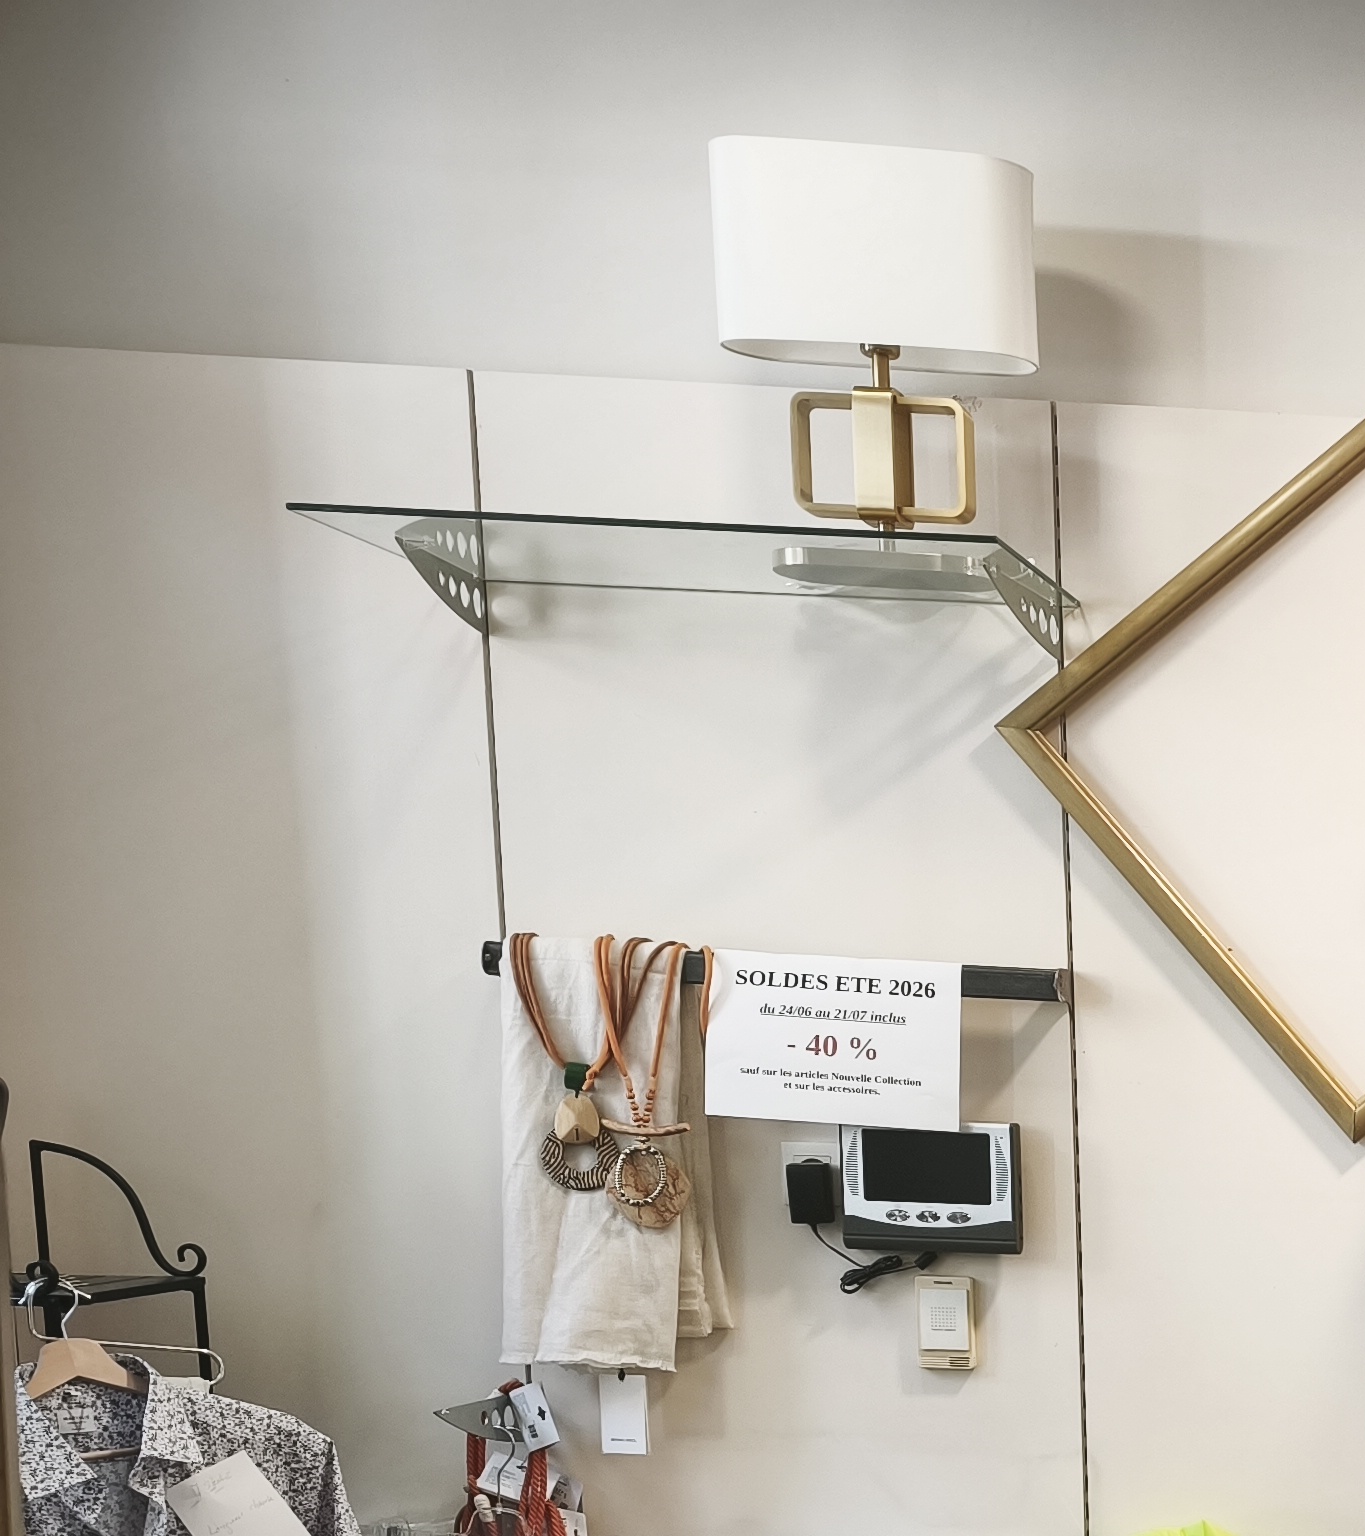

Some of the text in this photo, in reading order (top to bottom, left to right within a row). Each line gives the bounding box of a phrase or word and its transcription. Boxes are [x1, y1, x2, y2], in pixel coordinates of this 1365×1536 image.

[735, 969, 936, 999] SOLDES ETE 2026
[759, 1002, 906, 1024] du 24/06 au 21/07 inclus
[805, 1034, 838, 1057] 40
[849, 1036, 877, 1061] %
[739, 1066, 760, 1075] sauf
[780, 1068, 792, 1077] les
[794, 1070, 829, 1080] articles
[831, 1072, 872, 1083] Nouvelle
[874, 1075, 922, 1087] Collection
[794, 1083, 810, 1091] sur
[812, 1082, 825, 1091] les
